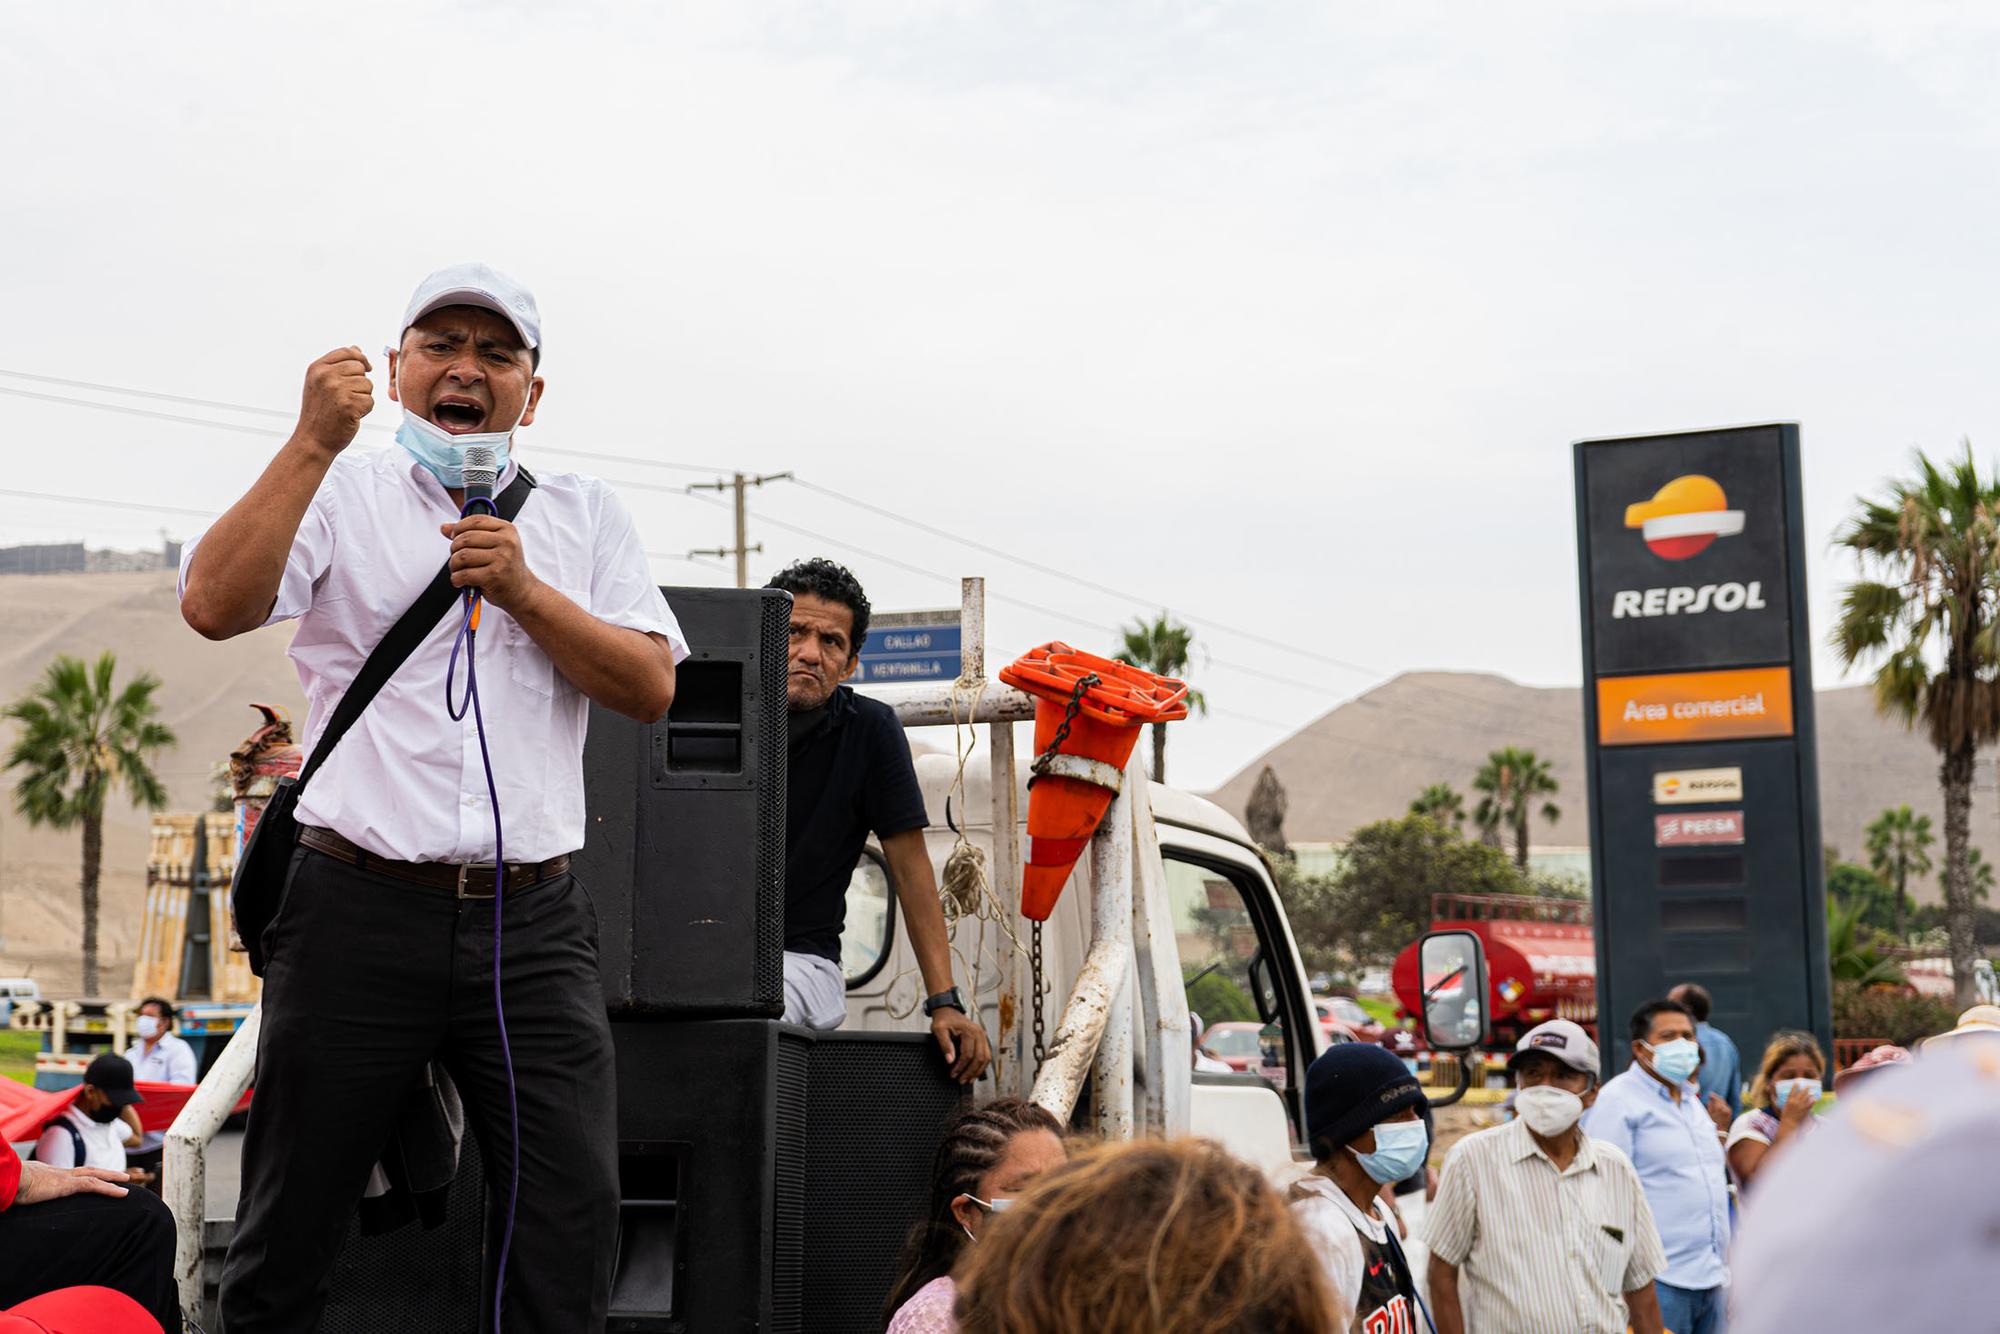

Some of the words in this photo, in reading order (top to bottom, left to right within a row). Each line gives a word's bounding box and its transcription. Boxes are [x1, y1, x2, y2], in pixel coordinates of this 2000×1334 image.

[1612, 581, 1767, 619] REPSOL
[884, 633, 932, 650] CALLAO
[872, 660, 942, 676] VENTANILLA
[1672, 691, 1766, 719] comercial
